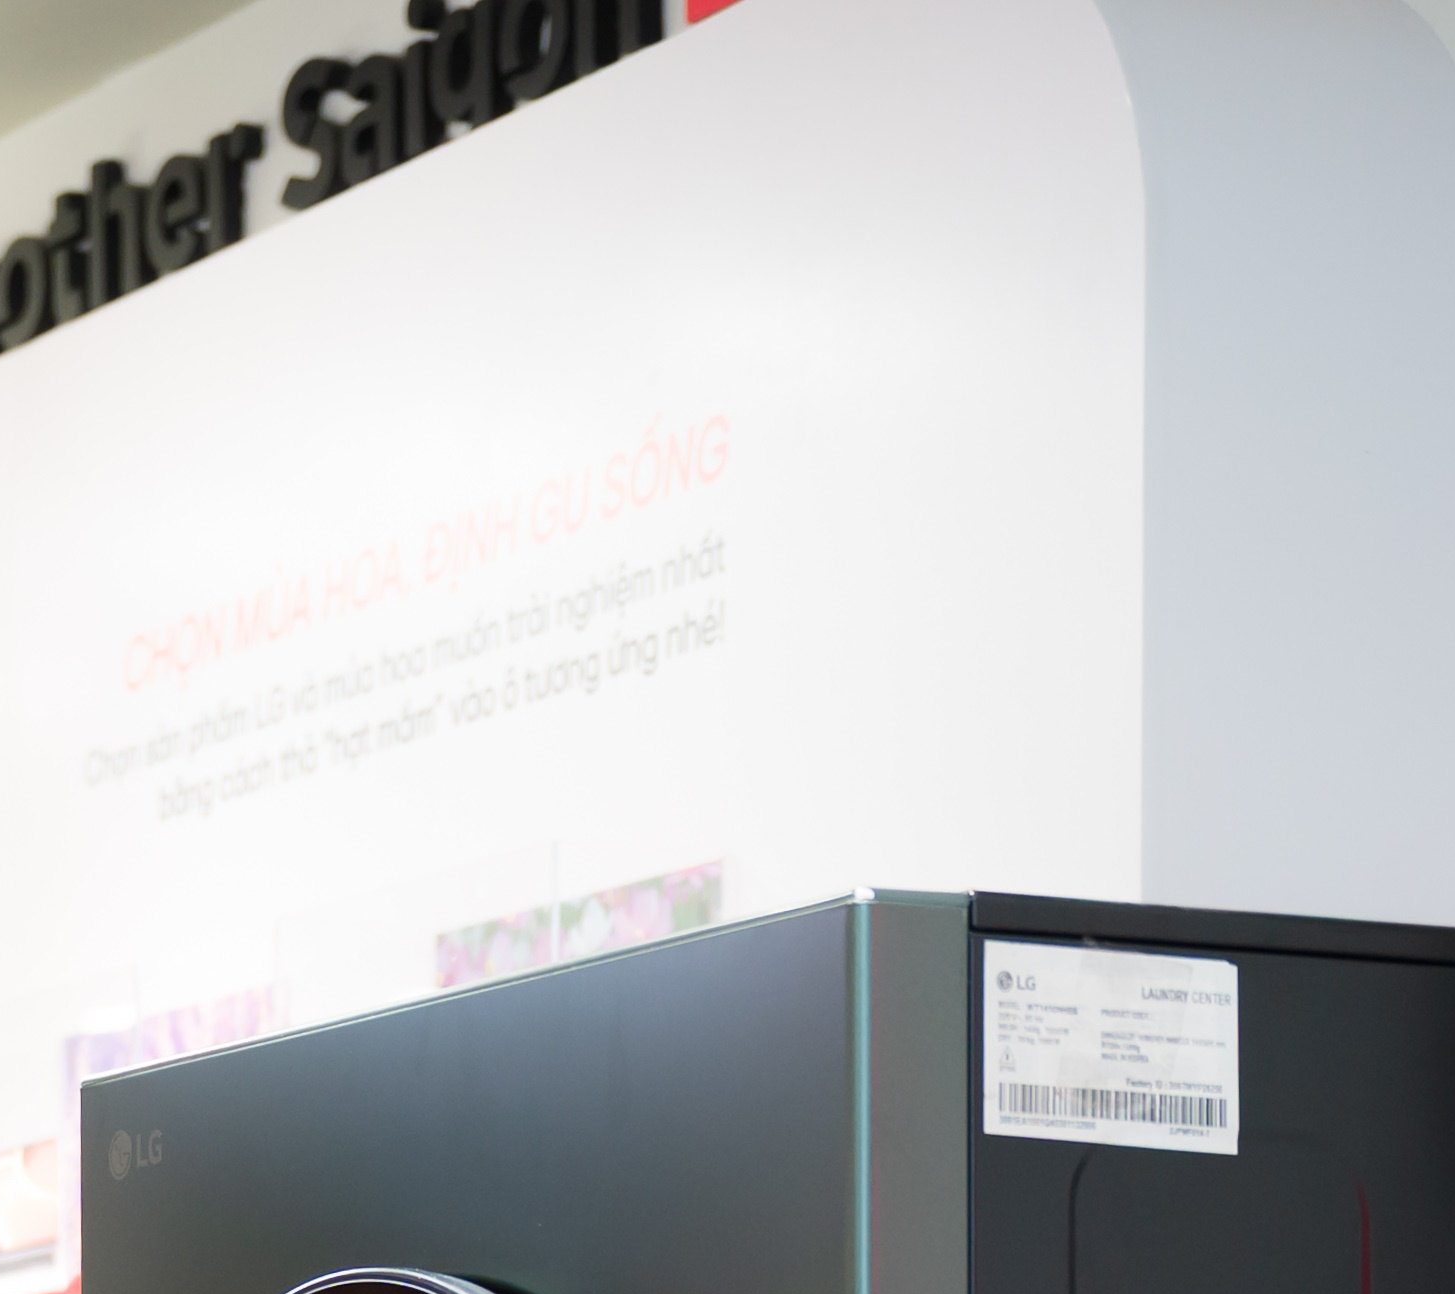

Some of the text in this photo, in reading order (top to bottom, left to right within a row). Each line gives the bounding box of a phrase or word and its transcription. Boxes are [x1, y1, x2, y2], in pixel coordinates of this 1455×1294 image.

[122, 411, 731, 693] CHỌN MÙA HOA, ĐỊNH GU SỐNG
[254, 686, 286, 730] LG
[1190, 990, 1232, 1007] CENTER
